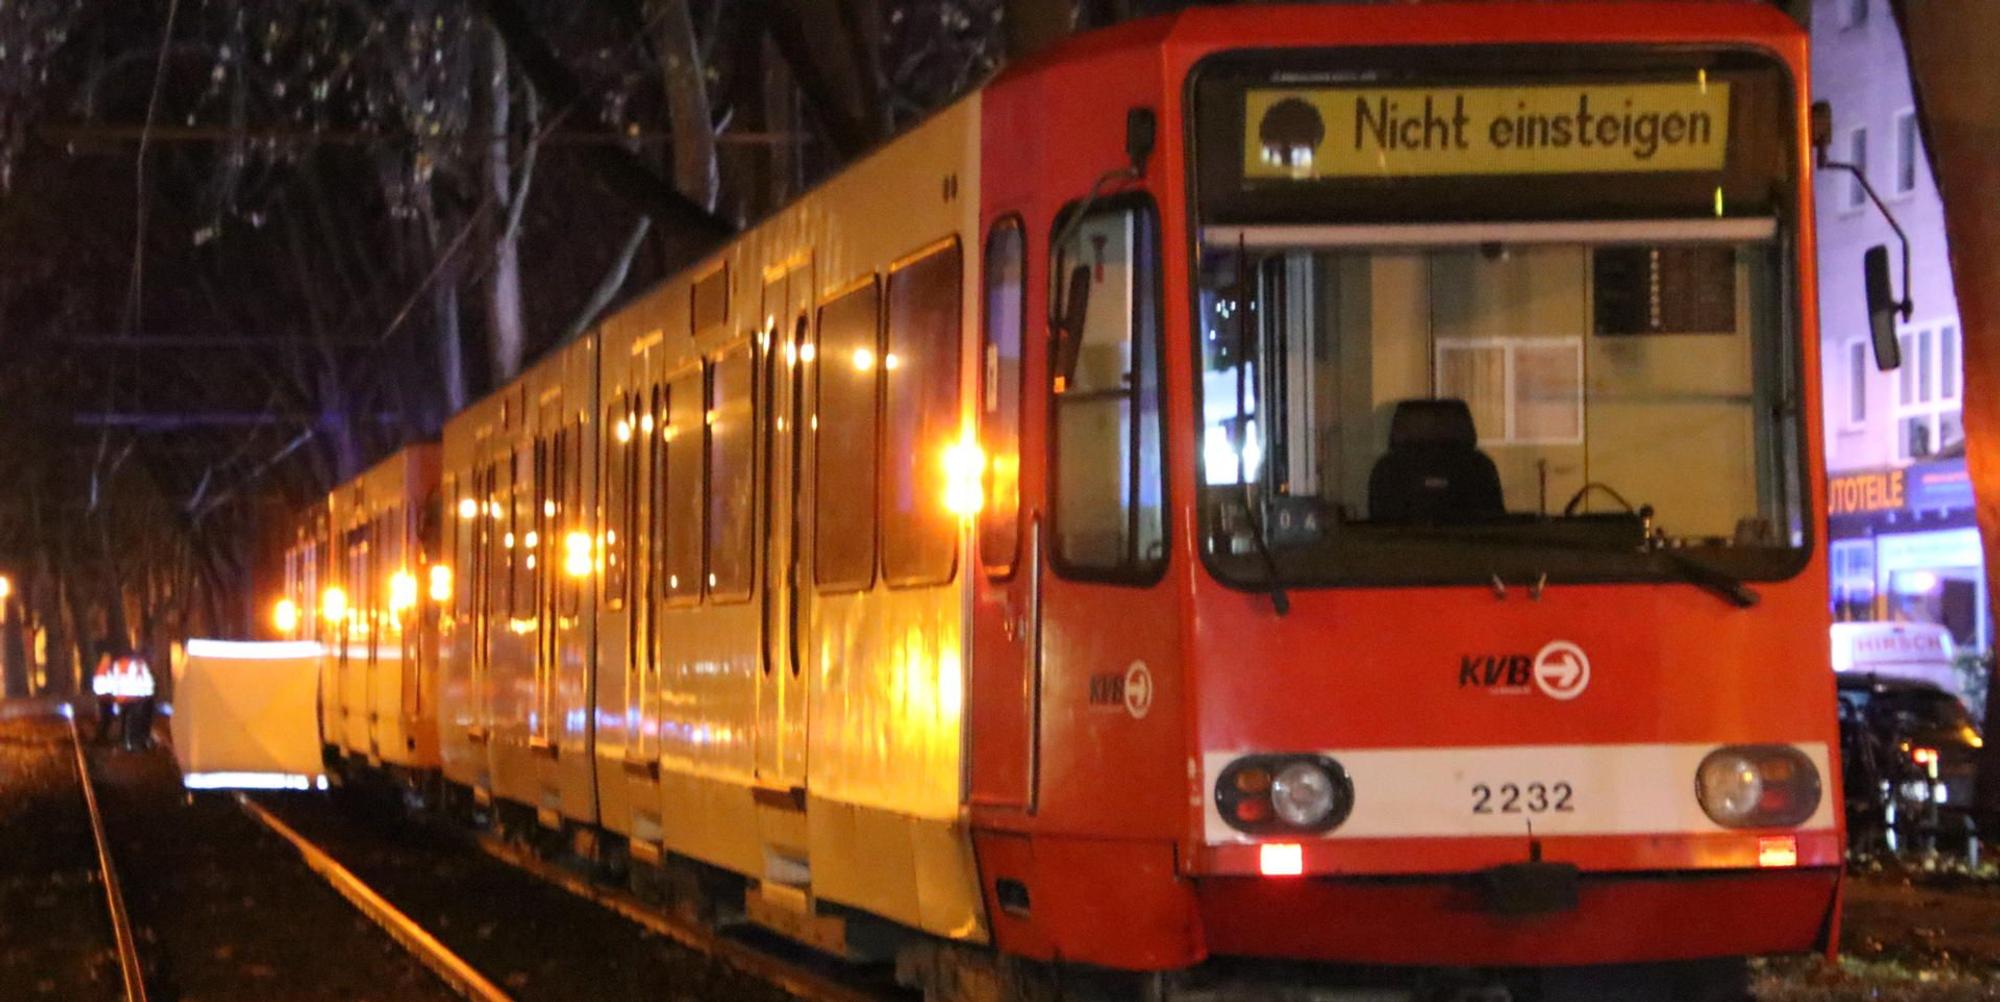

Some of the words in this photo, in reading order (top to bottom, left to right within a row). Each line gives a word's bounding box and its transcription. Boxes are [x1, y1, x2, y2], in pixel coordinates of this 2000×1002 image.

[1355, 95, 1469, 149] Nicht
[1489, 94, 1711, 159] einsteigen
[1459, 655, 1532, 687] KVB
[1089, 673, 1125, 704] KVB
[1472, 782, 1574, 814] 2232
